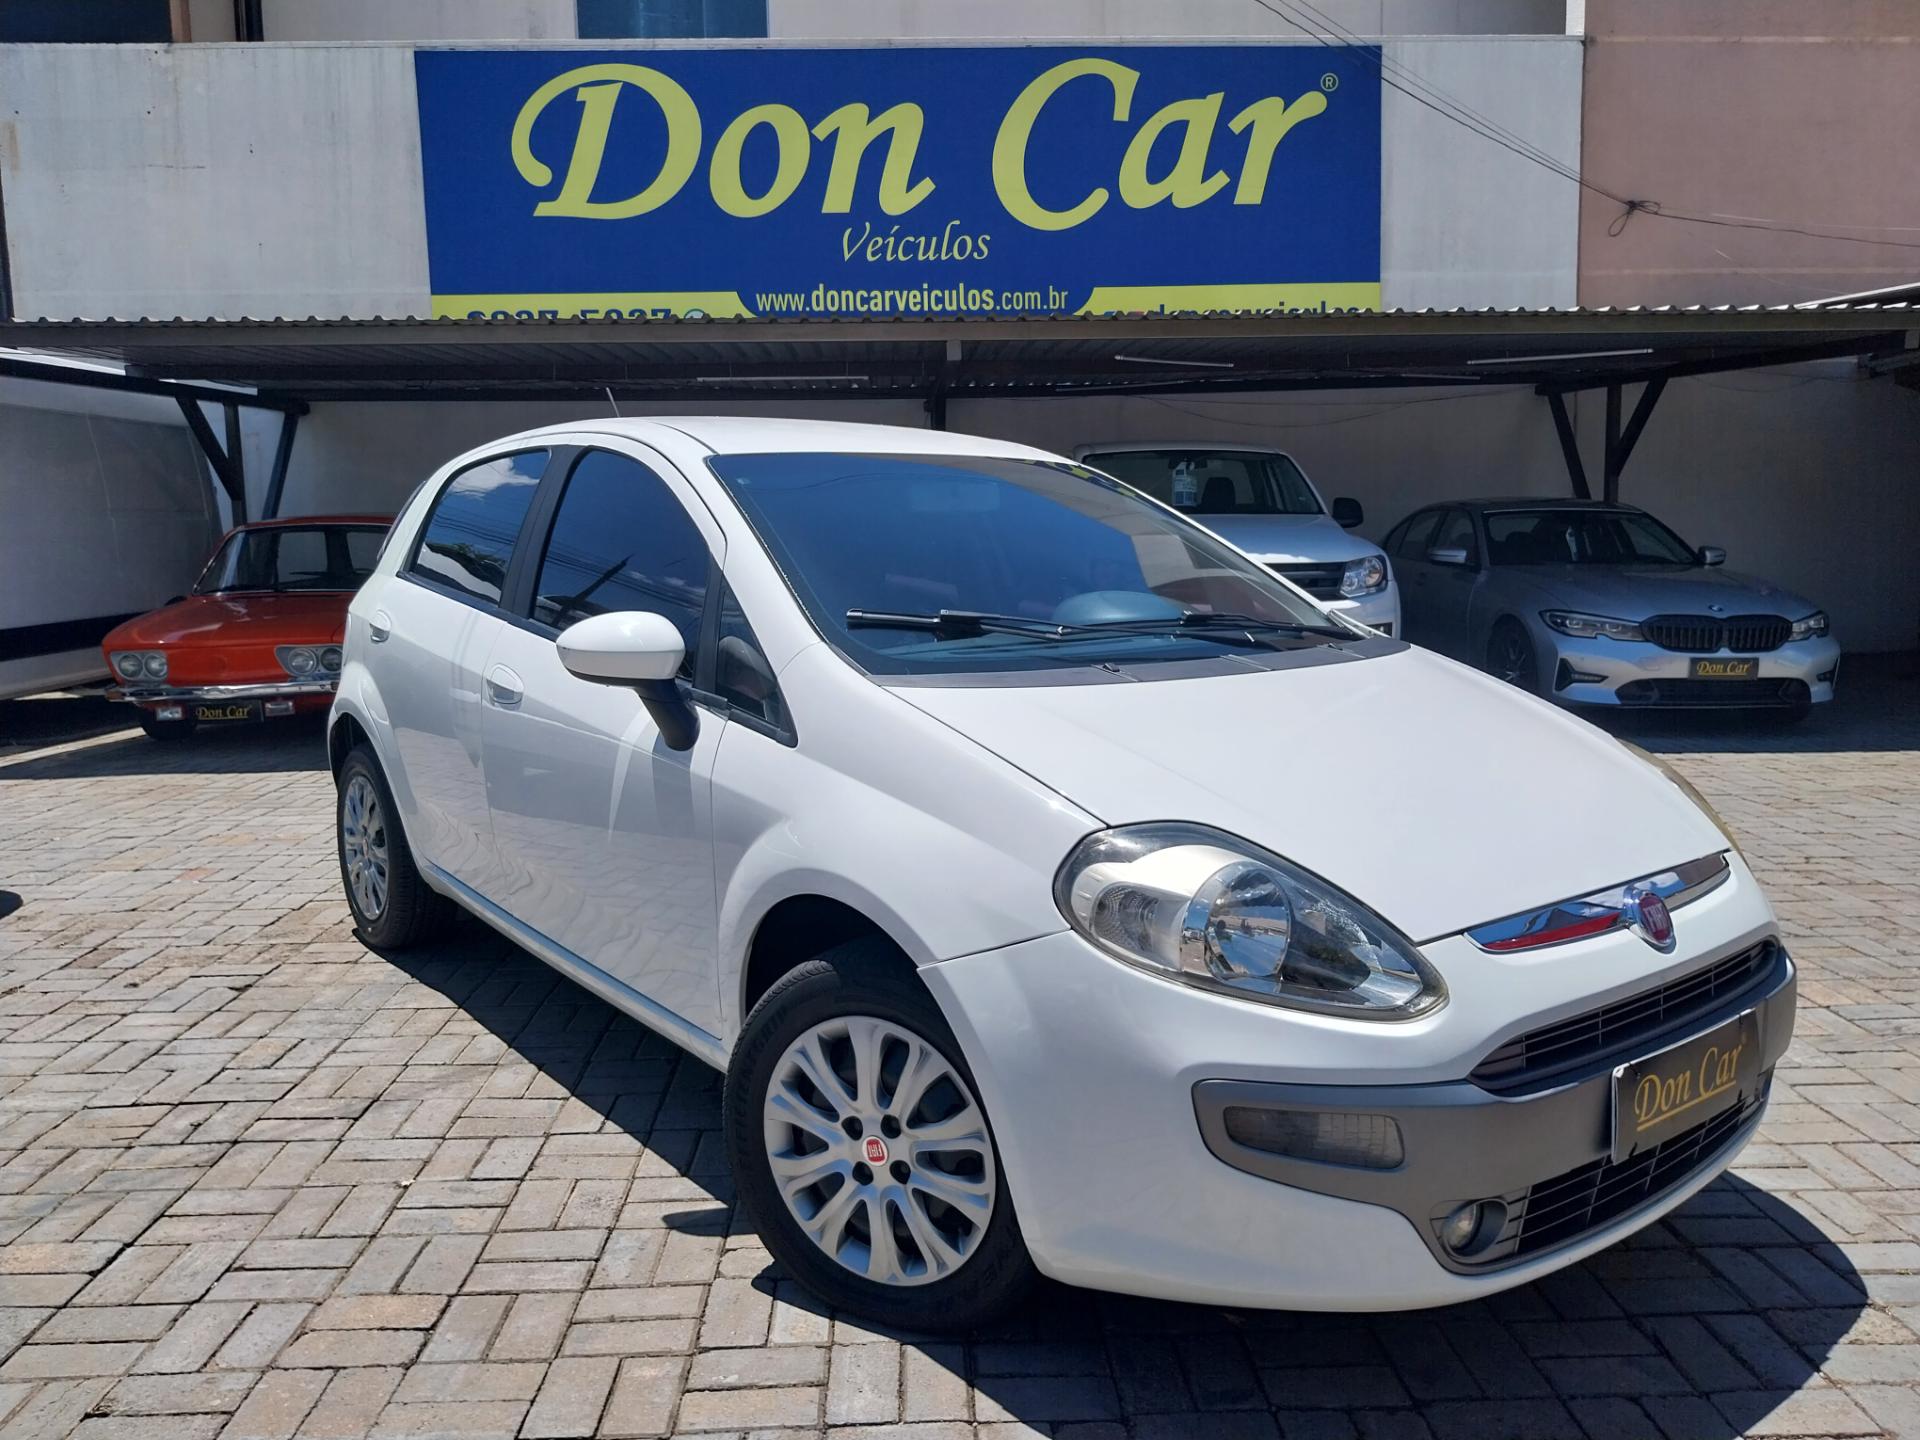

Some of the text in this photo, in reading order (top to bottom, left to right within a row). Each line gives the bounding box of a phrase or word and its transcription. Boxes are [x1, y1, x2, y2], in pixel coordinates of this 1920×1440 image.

[511, 63, 936, 220] Don
[992, 57, 1328, 231] Car
[842, 220, 991, 262] Veículos
[756, 283, 1068, 312] www.doncarveiculos.com.br
[1696, 660, 1751, 675] Don Car
[195, 705, 250, 719] Don Car
[1634, 1042, 1743, 1124] Don Car
